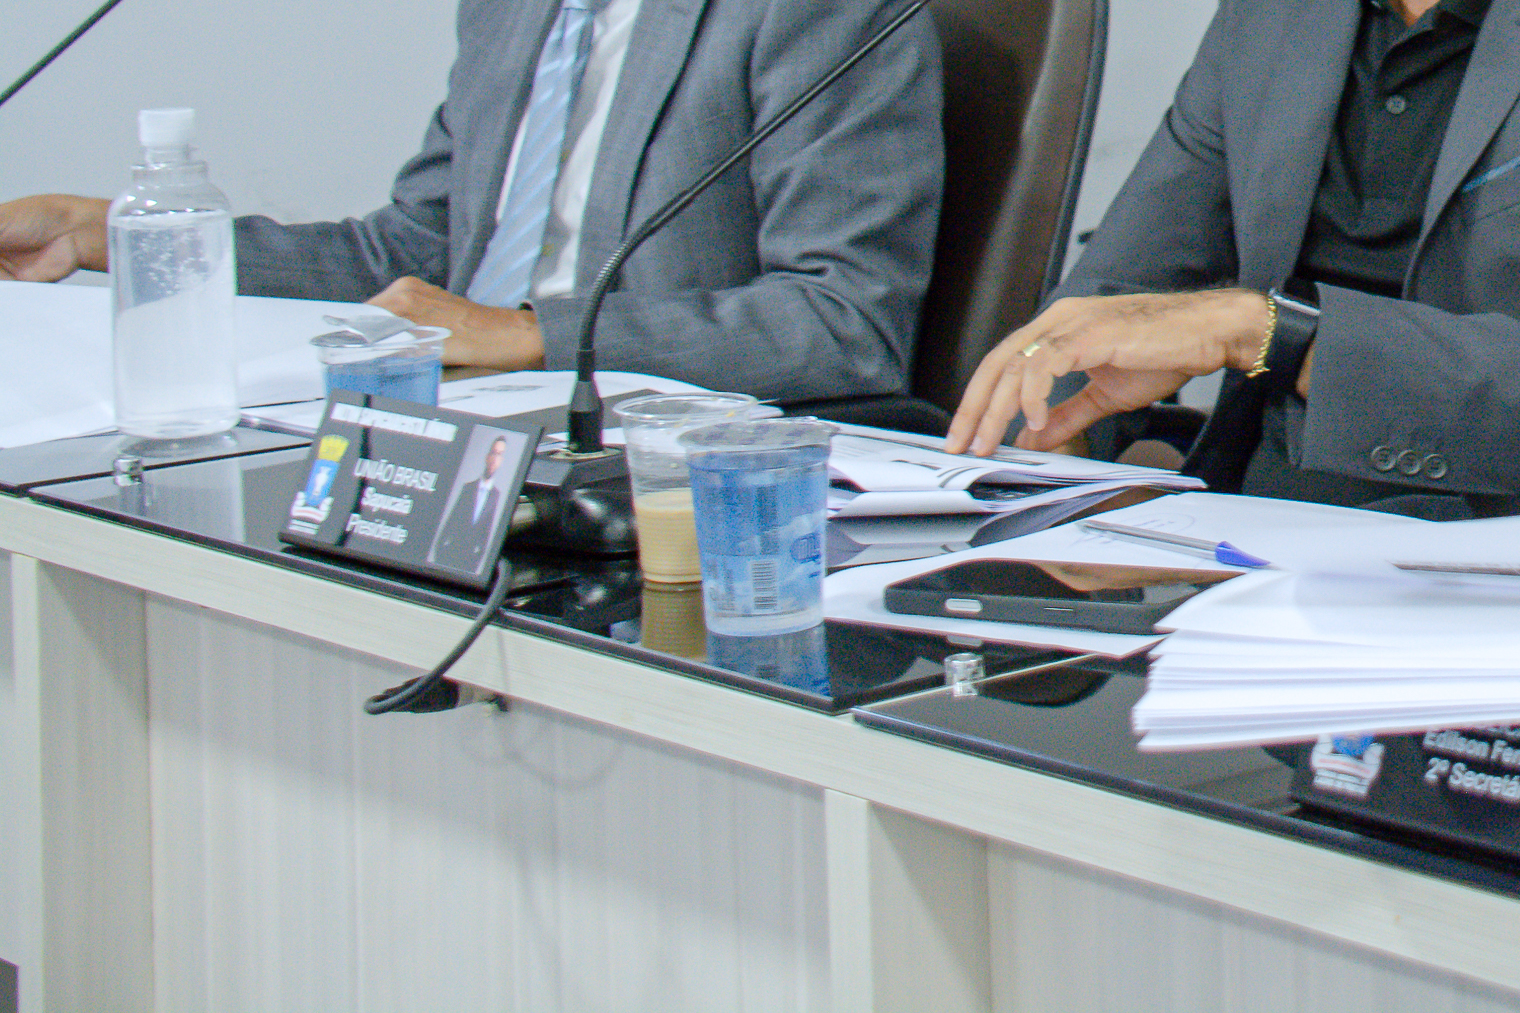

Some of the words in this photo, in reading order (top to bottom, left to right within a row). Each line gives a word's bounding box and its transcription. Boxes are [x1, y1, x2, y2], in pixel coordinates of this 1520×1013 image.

[354, 458, 396, 482] UNIÃO
[393, 466, 439, 491] BRASIL
[346, 513, 409, 543] Presidente
[1423, 730, 1489, 759] Edilson
